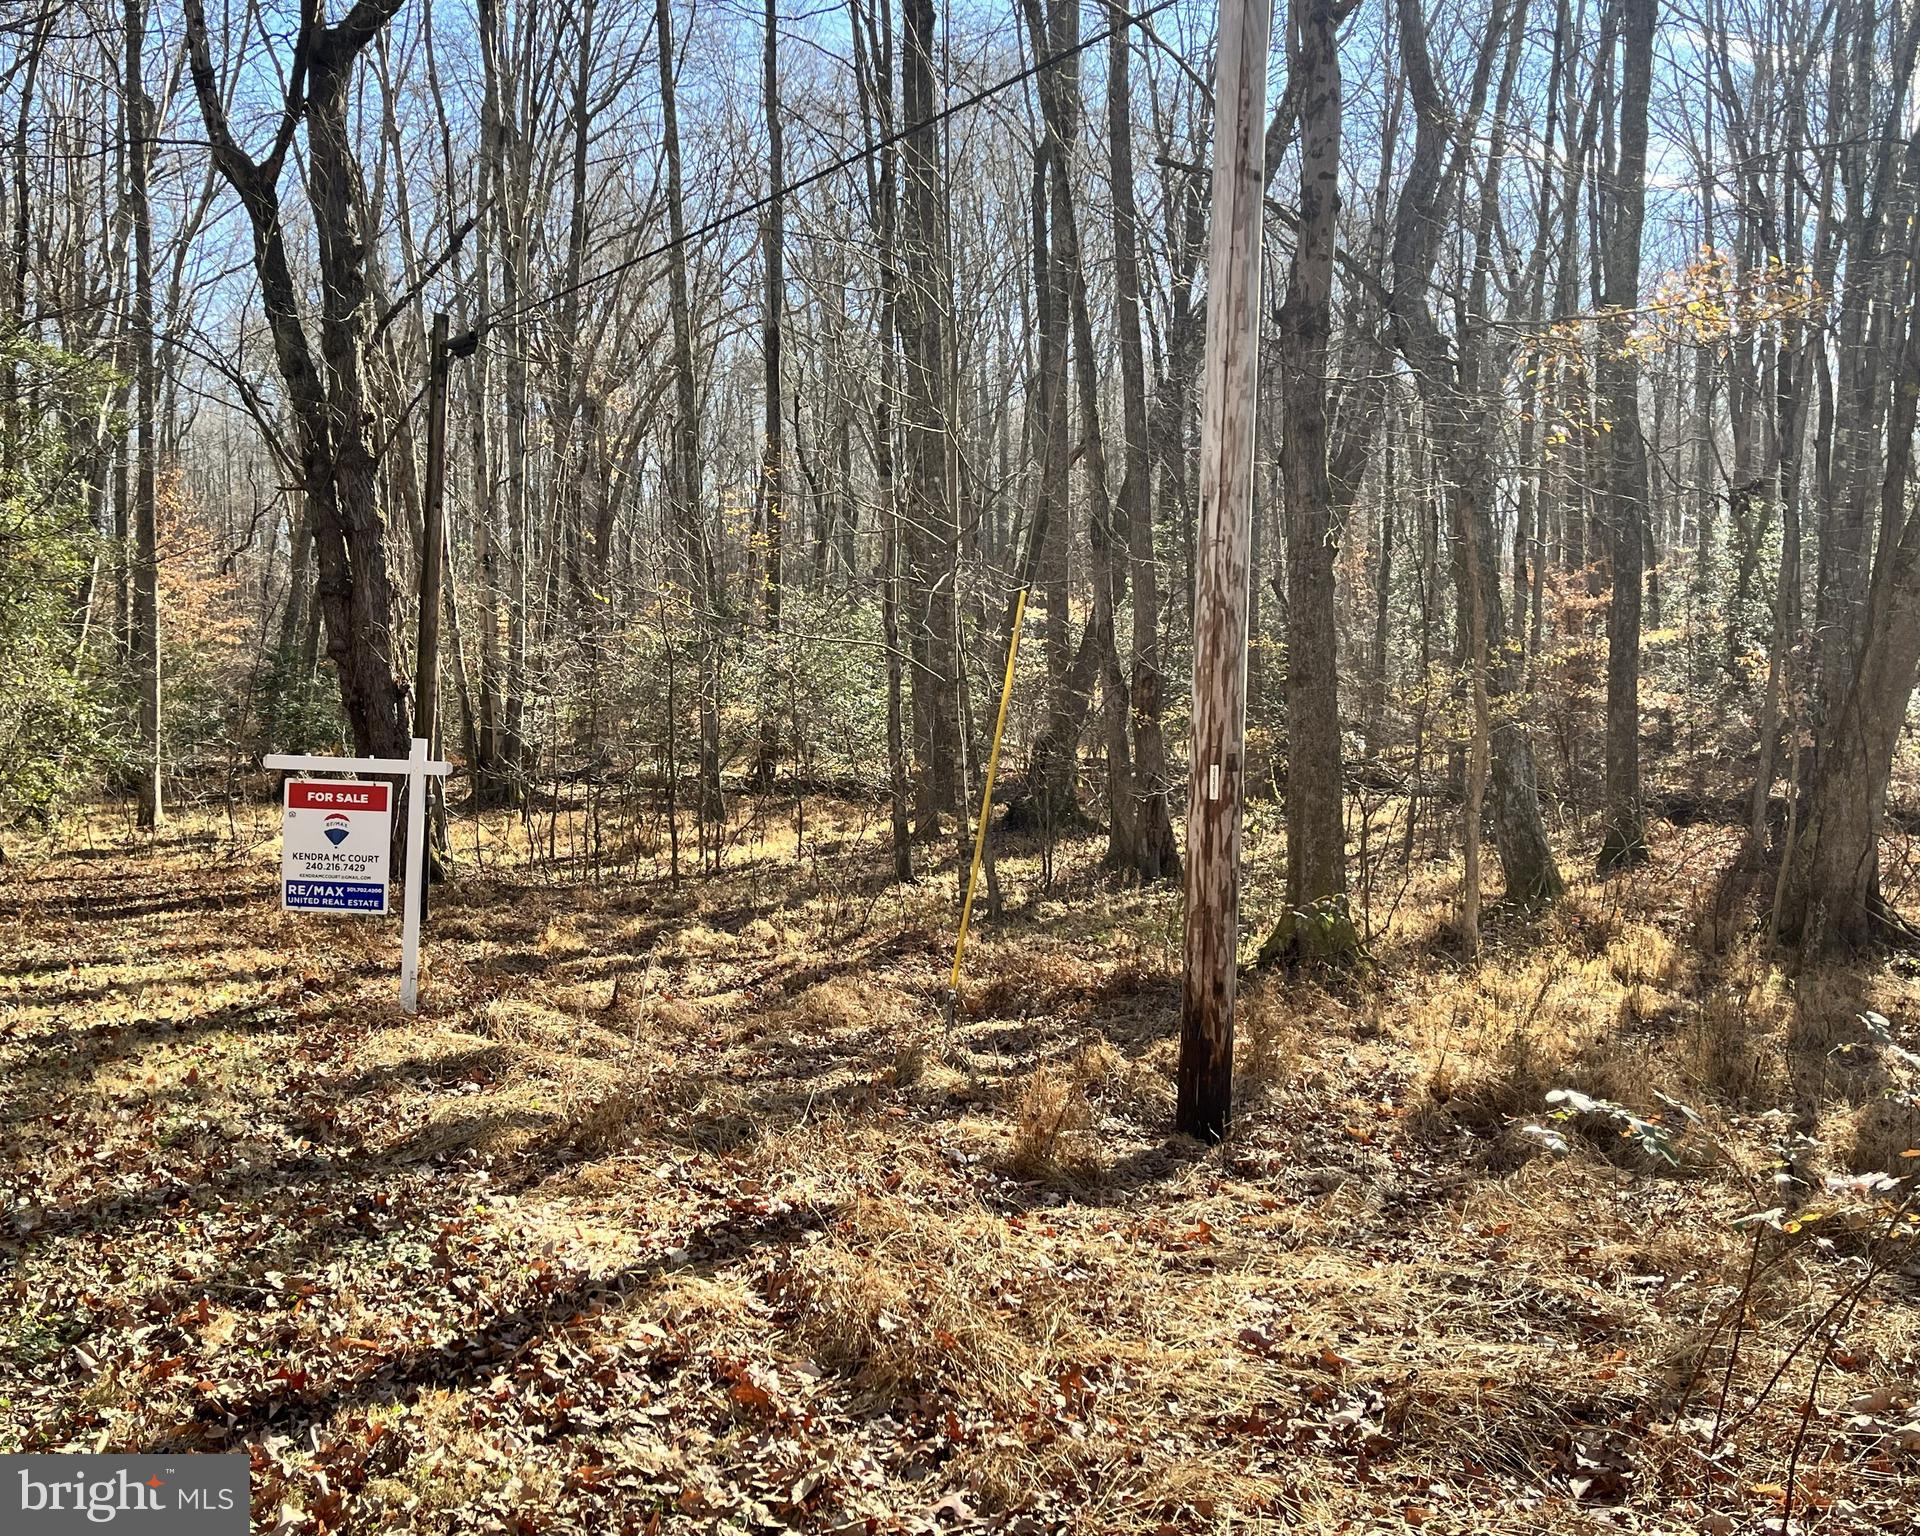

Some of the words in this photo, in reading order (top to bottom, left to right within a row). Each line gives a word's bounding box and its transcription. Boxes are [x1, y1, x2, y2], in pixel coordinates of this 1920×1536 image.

[307, 792, 333, 802] FOR
[336, 793, 369, 803] SALE
[292, 852, 330, 861] KENDRA
[333, 854, 346, 862] MC
[348, 854, 380, 863] COURT
[305, 862, 366, 872] 240.216.7429
[288, 884, 344, 897] RE/MAX
[287, 896, 320, 905] UNITED
[322, 898, 345, 906] REAL
[347, 899, 380, 907] ESTATE
